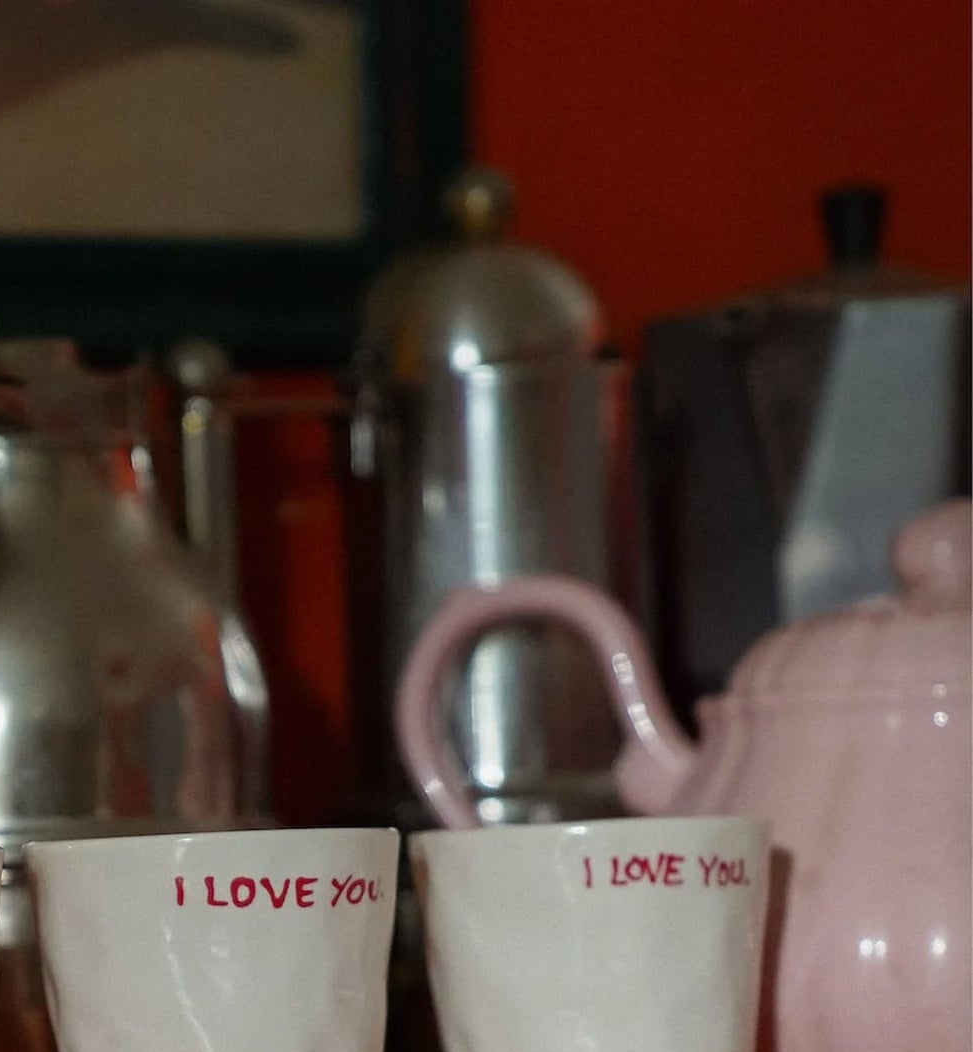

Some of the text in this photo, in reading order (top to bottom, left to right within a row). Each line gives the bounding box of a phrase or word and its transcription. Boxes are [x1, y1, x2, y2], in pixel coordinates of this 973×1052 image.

[583, 853, 751, 888] I LOVE YOU.
[174, 876, 185, 906] I
[204, 875, 318, 909] LOVE
